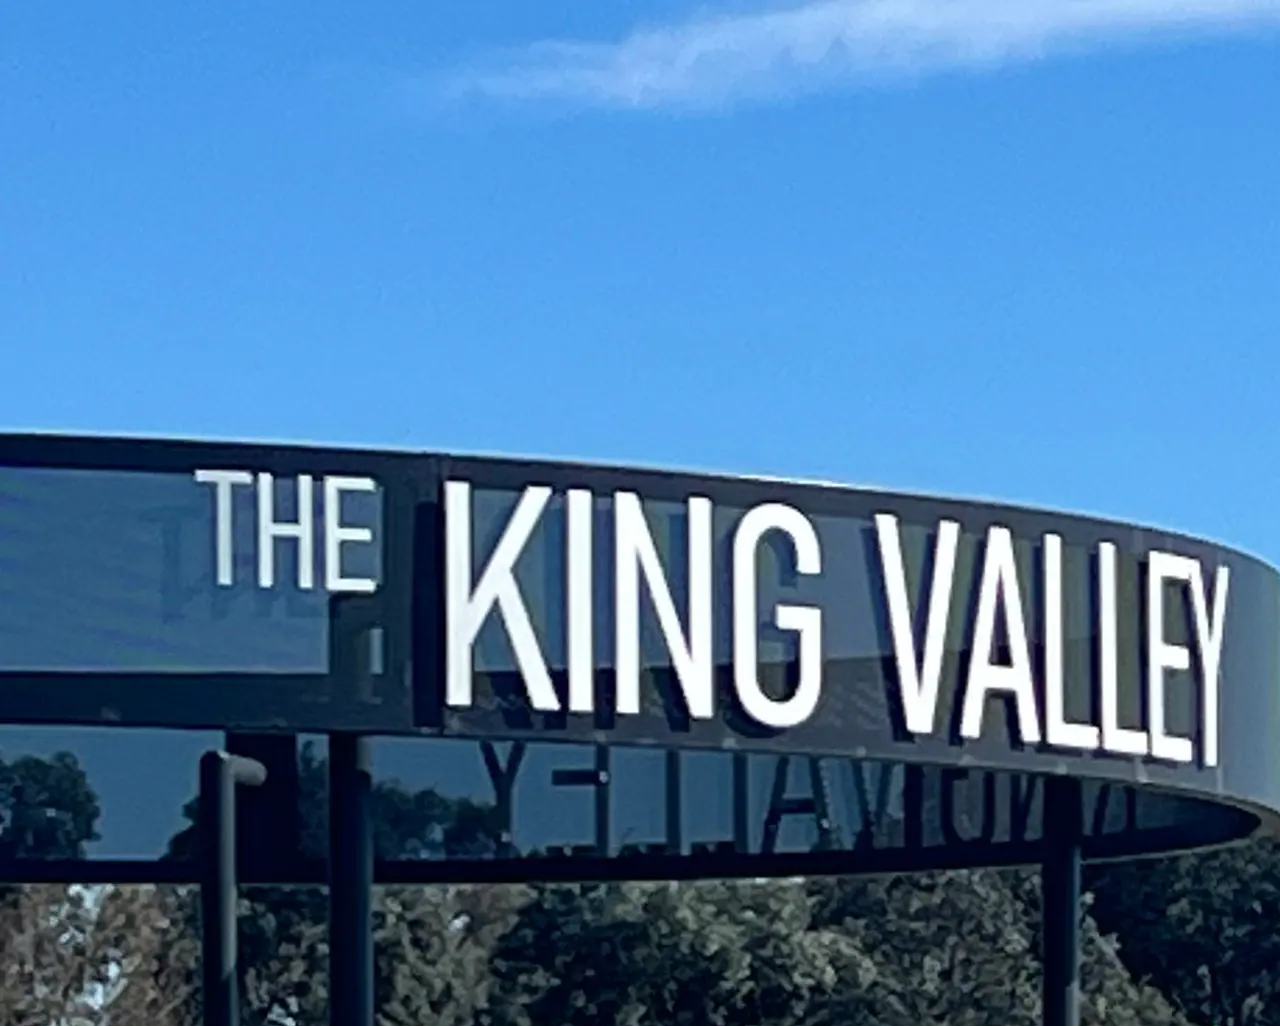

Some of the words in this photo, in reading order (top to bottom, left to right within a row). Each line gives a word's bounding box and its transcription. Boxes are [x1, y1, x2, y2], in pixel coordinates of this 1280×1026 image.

[194, 469, 378, 593] THE
[444, 479, 823, 728] KING
[874, 512, 1230, 768] VALLEY
